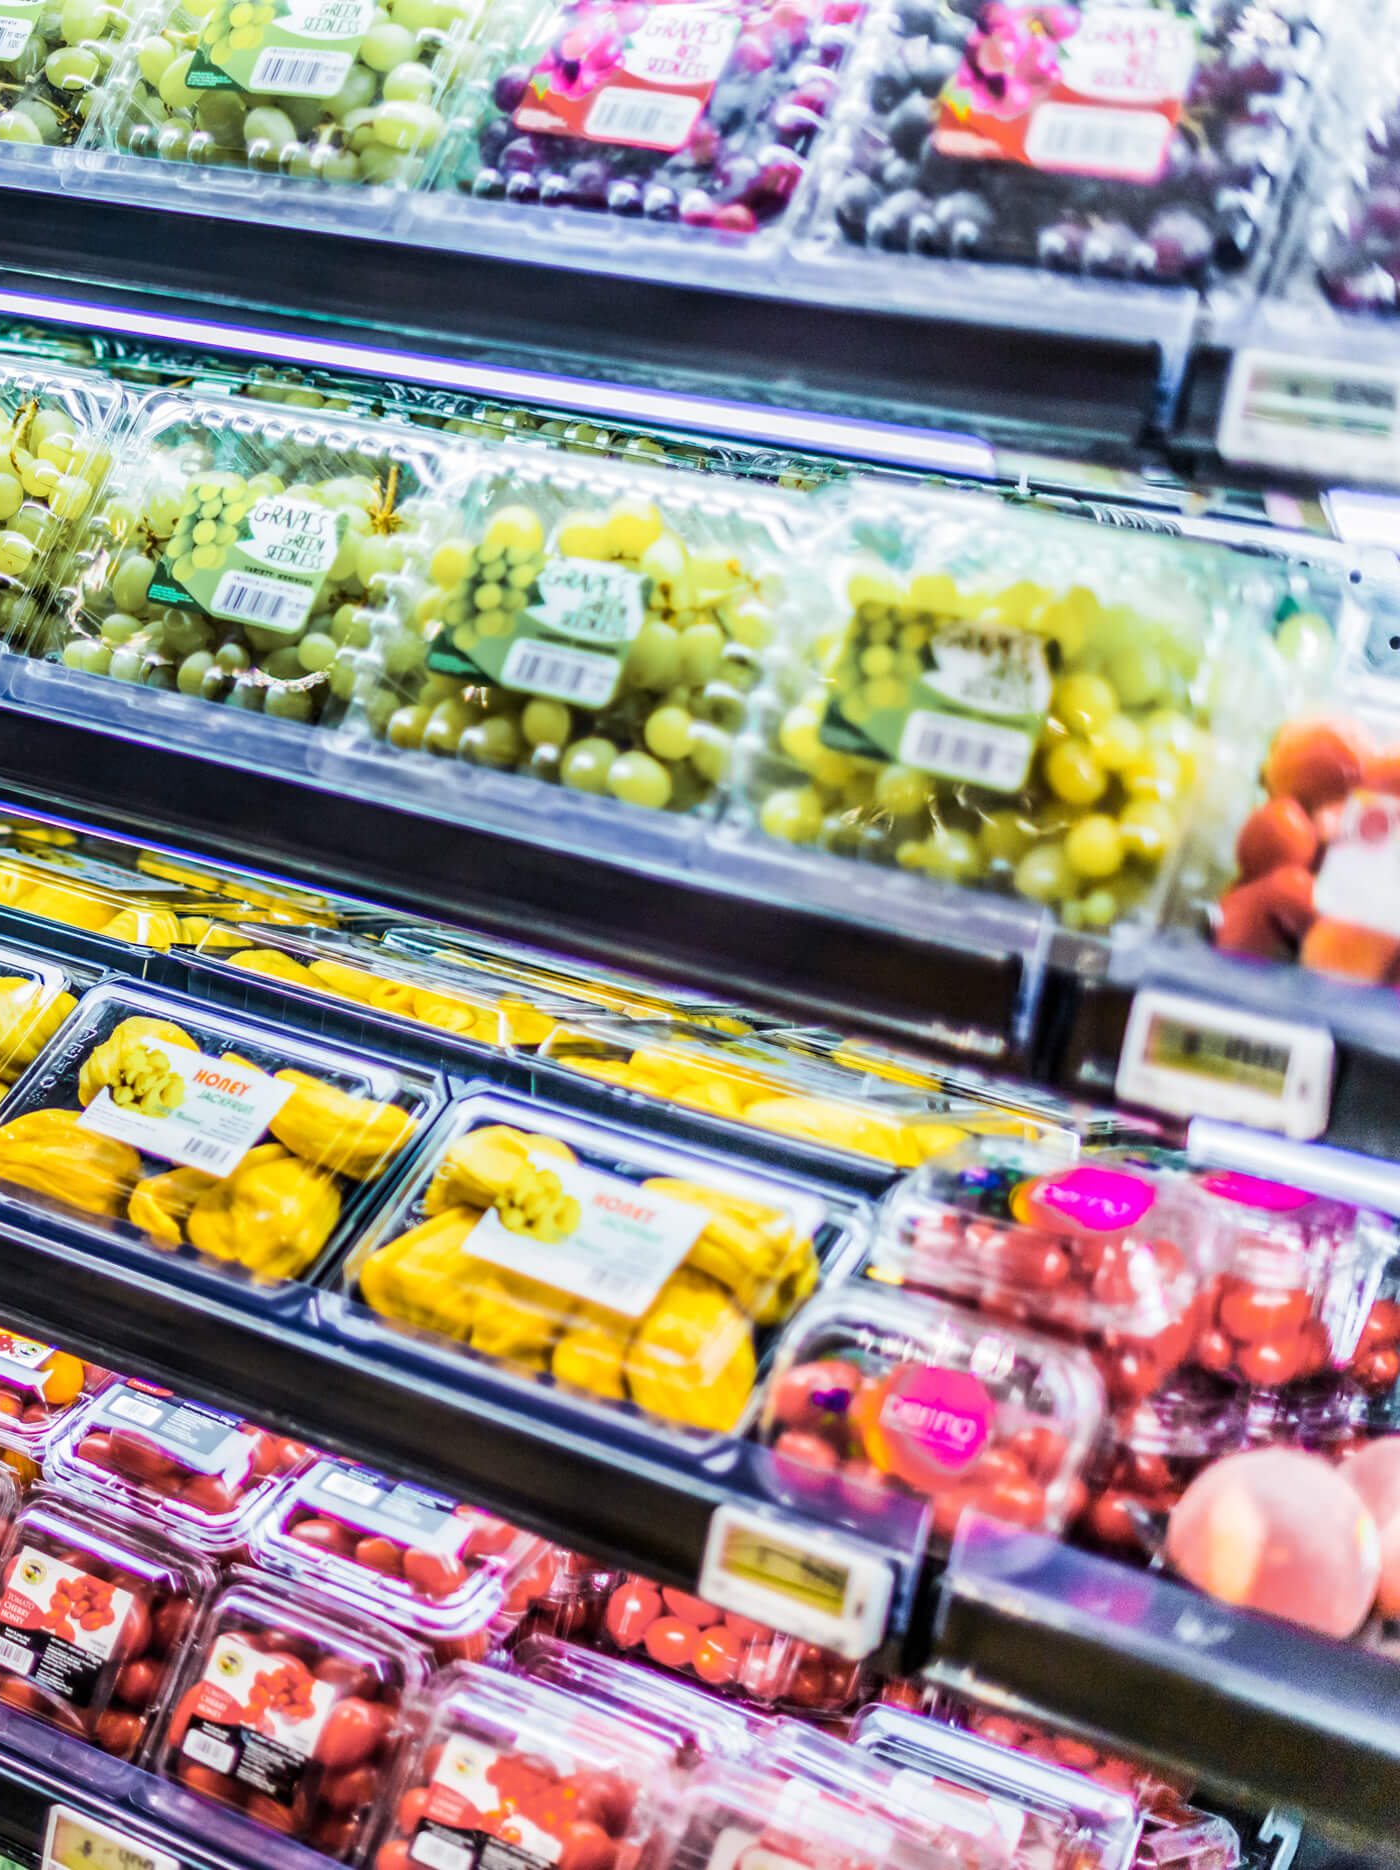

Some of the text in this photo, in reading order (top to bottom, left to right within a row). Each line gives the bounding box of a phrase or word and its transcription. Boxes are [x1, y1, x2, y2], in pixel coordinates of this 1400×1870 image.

[320, 2, 362, 16] GREEN
[303, 16, 360, 34] SEEDLESS
[254, 502, 330, 535] GRAPES
[282, 534, 326, 552] GREEN
[264, 544, 326, 570] SEEDLESS
[193, 1068, 251, 1097] HONEY
[197, 1090, 255, 1114] JACKFRUIT
[593, 1192, 656, 1223] HONEY
[4, 1600, 31, 1618] CHERRY
[7, 1591, 36, 1610] TOMATO
[0, 1609, 25, 1625] HONEY
